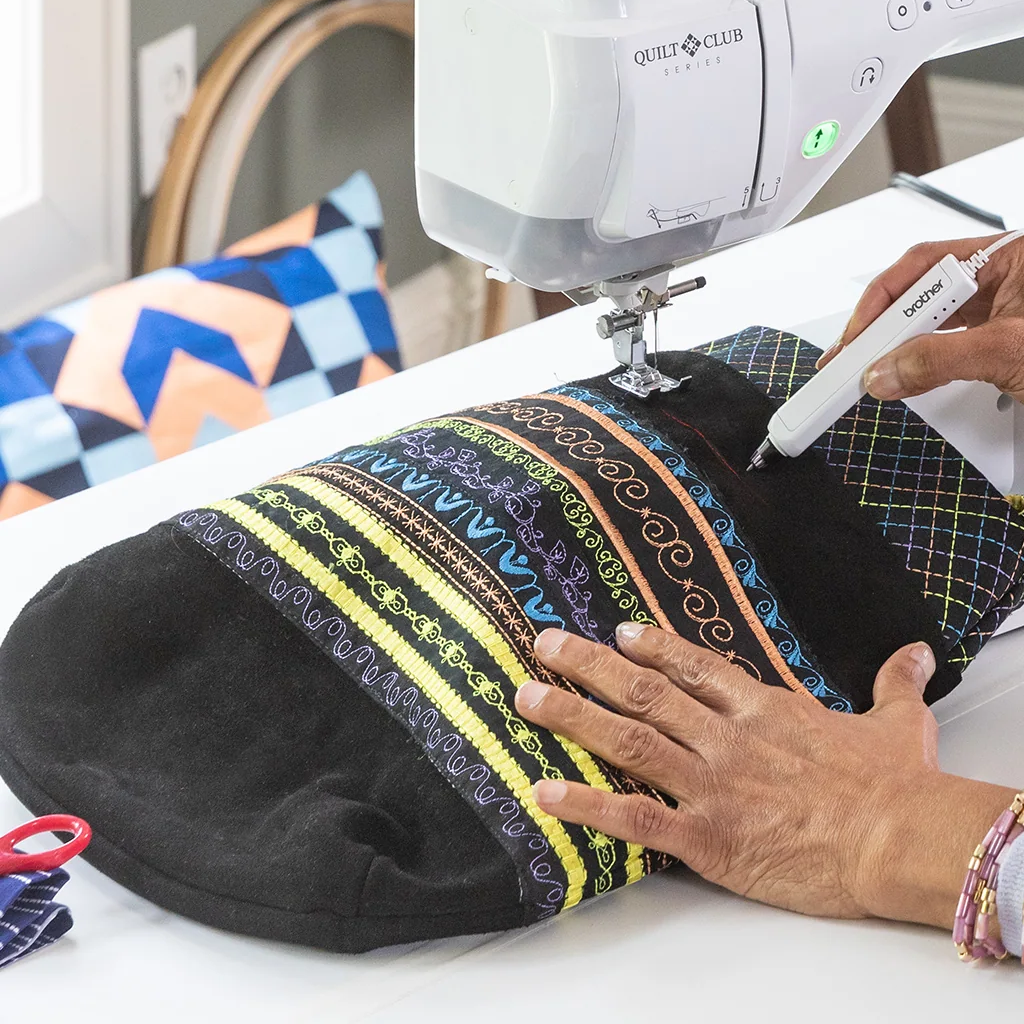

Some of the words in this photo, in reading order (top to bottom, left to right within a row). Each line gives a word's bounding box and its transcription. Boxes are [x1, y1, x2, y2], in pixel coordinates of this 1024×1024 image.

[634, 42, 679, 66] QUILT
[703, 28, 743, 49] CLUB
[664, 56, 721, 76] SERIES
[744, 186, 749, 194] 5
[775, 177, 781, 185] 3
[903, 279, 943, 317] brother
